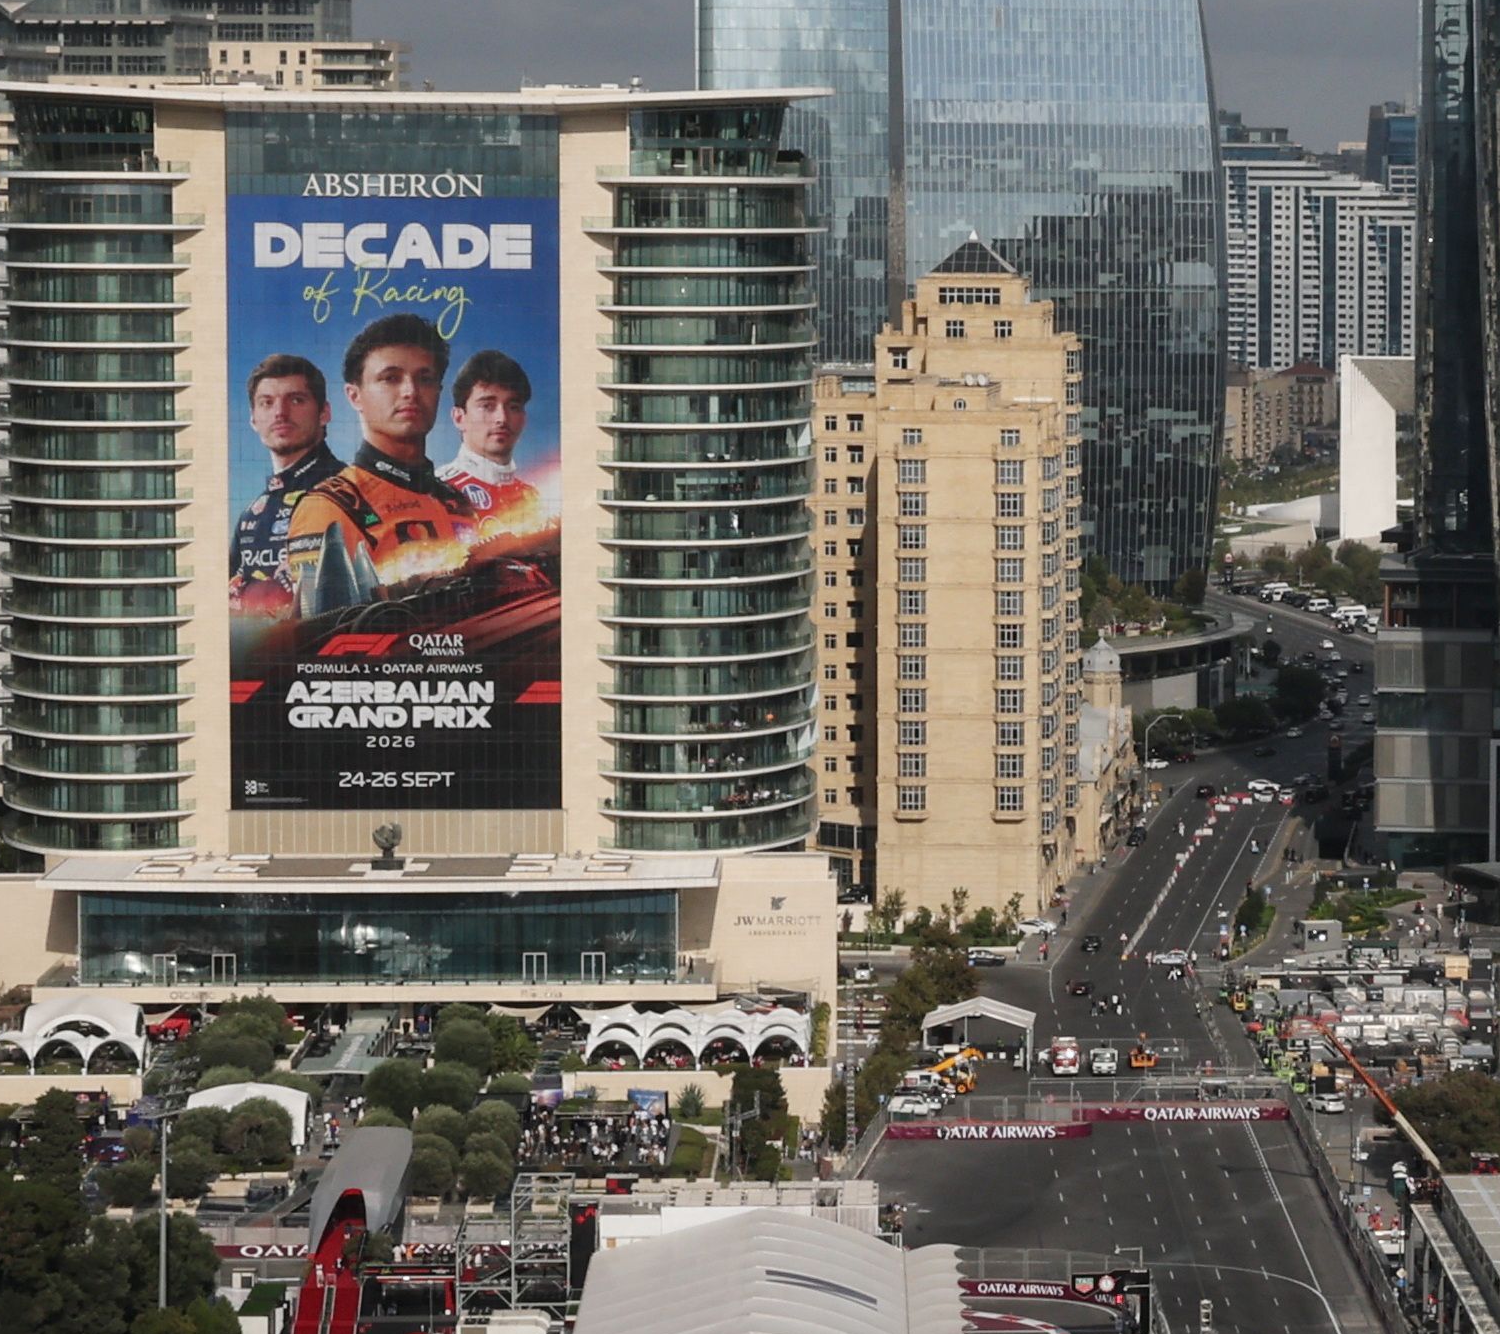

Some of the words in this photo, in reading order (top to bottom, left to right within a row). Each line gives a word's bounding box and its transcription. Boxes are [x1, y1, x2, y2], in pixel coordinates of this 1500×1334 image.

[302, 173, 483, 198] ABSHERON
[254, 222, 532, 269] DECADE
[303, 271, 340, 323] of
[353, 259, 473, 340] Racing
[240, 548, 288, 567] RACLE
[409, 634, 463, 649] QATAR
[422, 648, 464, 656] AIRWAYS
[297, 664, 360, 674] FORMULA
[382, 664, 423, 674] QATAR
[426, 664, 483, 674] AIRWAYS
[285, 681, 495, 703] AZERBAIJAN
[288, 706, 408, 728] GRAND
[412, 706, 492, 728] PRIX
[366, 736, 415, 748] 2026
[339, 772, 398, 787] 24-26
[402, 772, 455, 787] SEPT
[734, 916, 754, 926] JW
[757, 916, 821, 926] MARRIOTT
[1144, 1107, 1193, 1121] QATAR
[1197, 1107, 1260, 1120] AIRWAYS
[992, 1125, 1056, 1139] AIRWAYS
[240, 1244, 309, 1259] QATA
[978, 1283, 1017, 1294] QATAR
[1019, 1284, 1064, 1296] AIRWAYS
